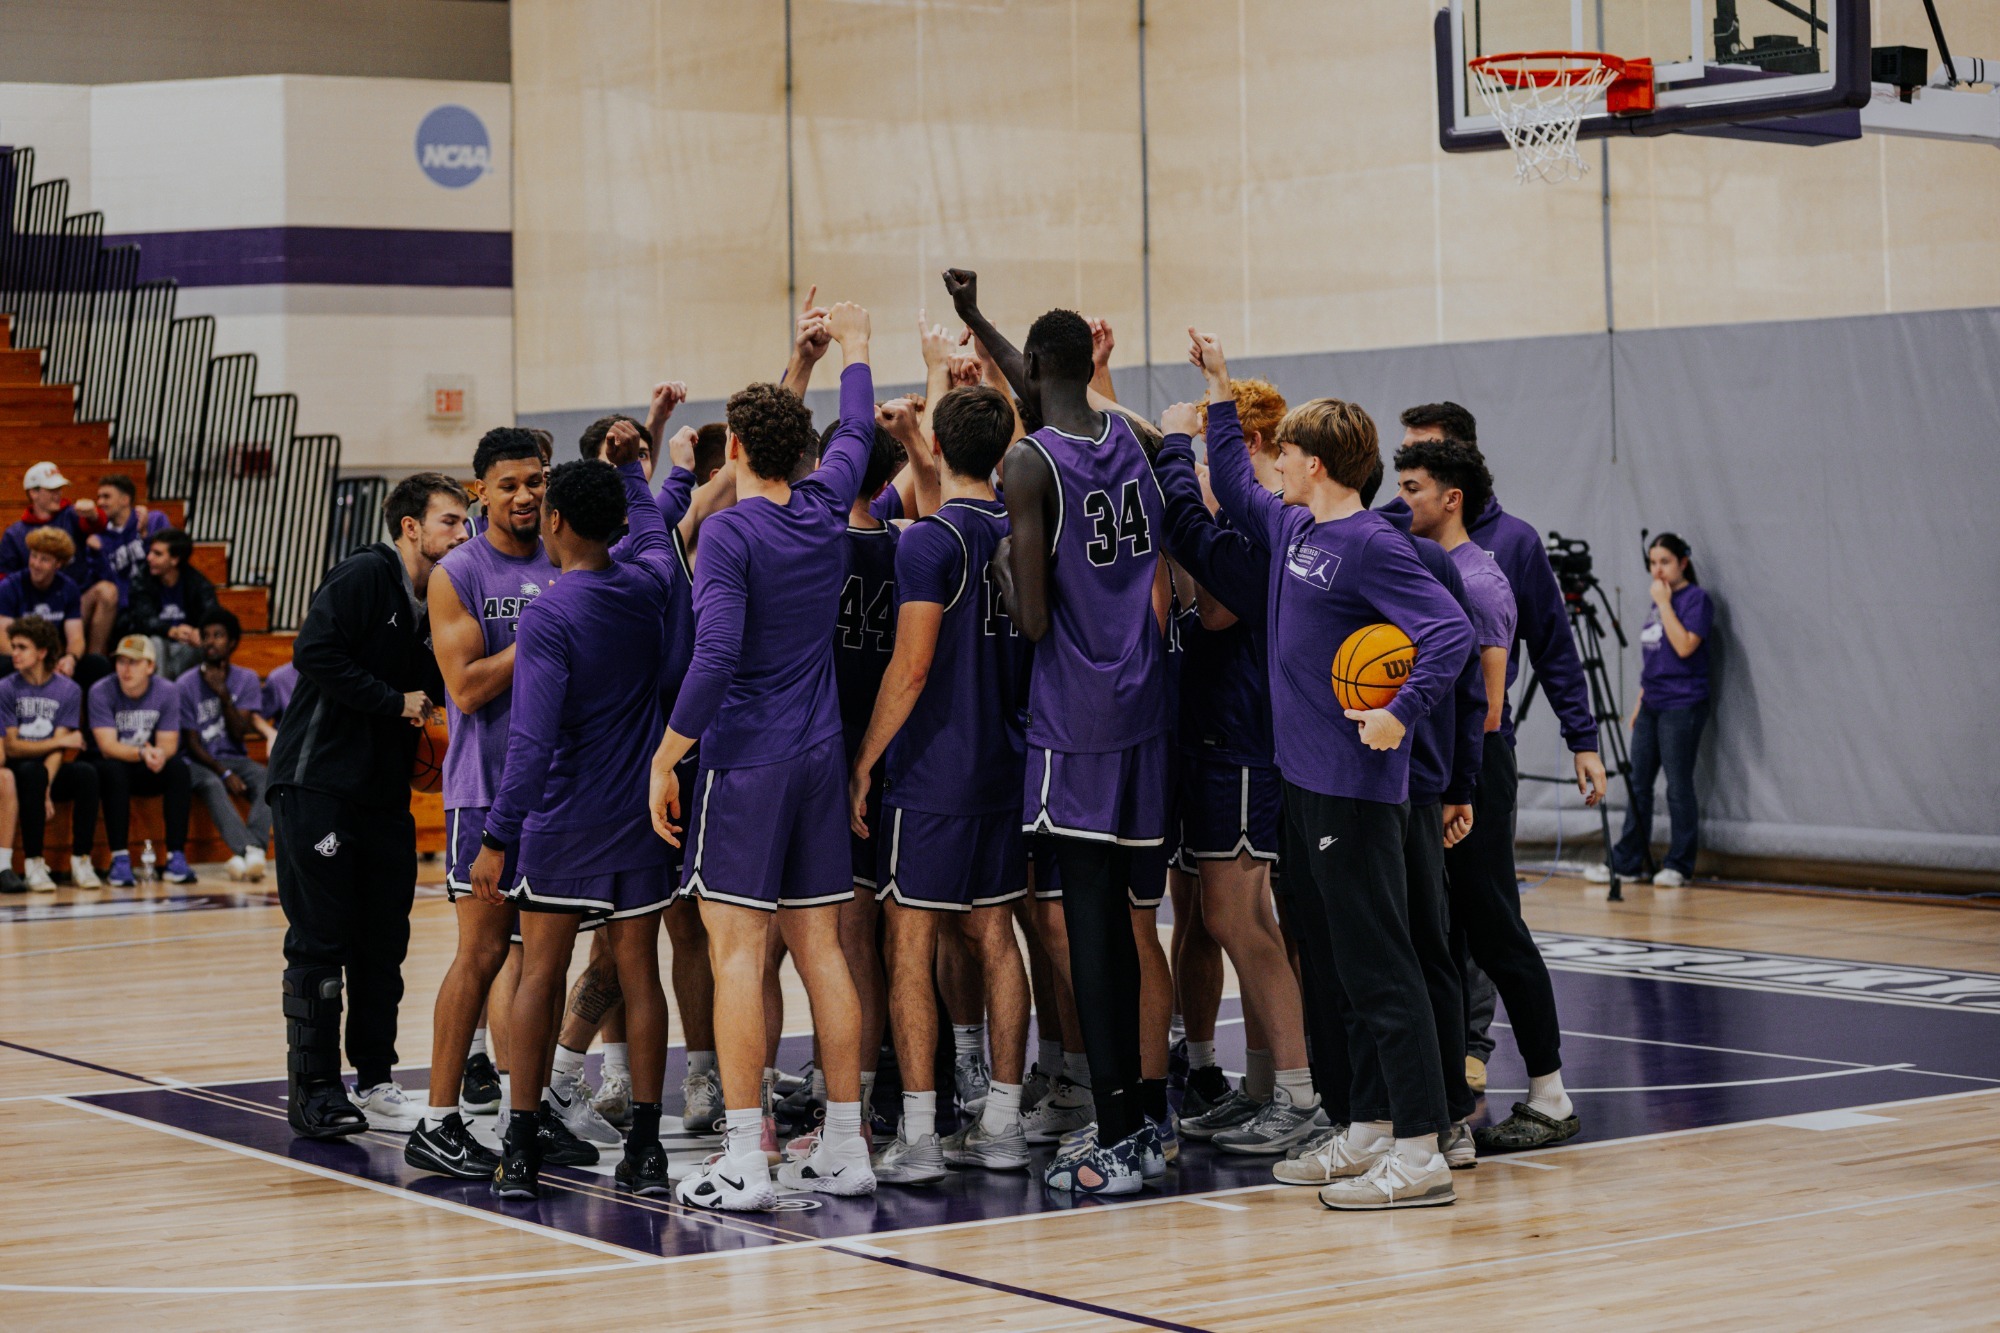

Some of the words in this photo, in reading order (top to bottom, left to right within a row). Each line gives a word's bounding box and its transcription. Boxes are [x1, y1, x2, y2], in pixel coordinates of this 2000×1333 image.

[422, 144, 488, 168] NCAA
[1084, 478, 1152, 567] 34
[836, 574, 895, 652] 44
[1533, 936, 2000, 996] SBURY
